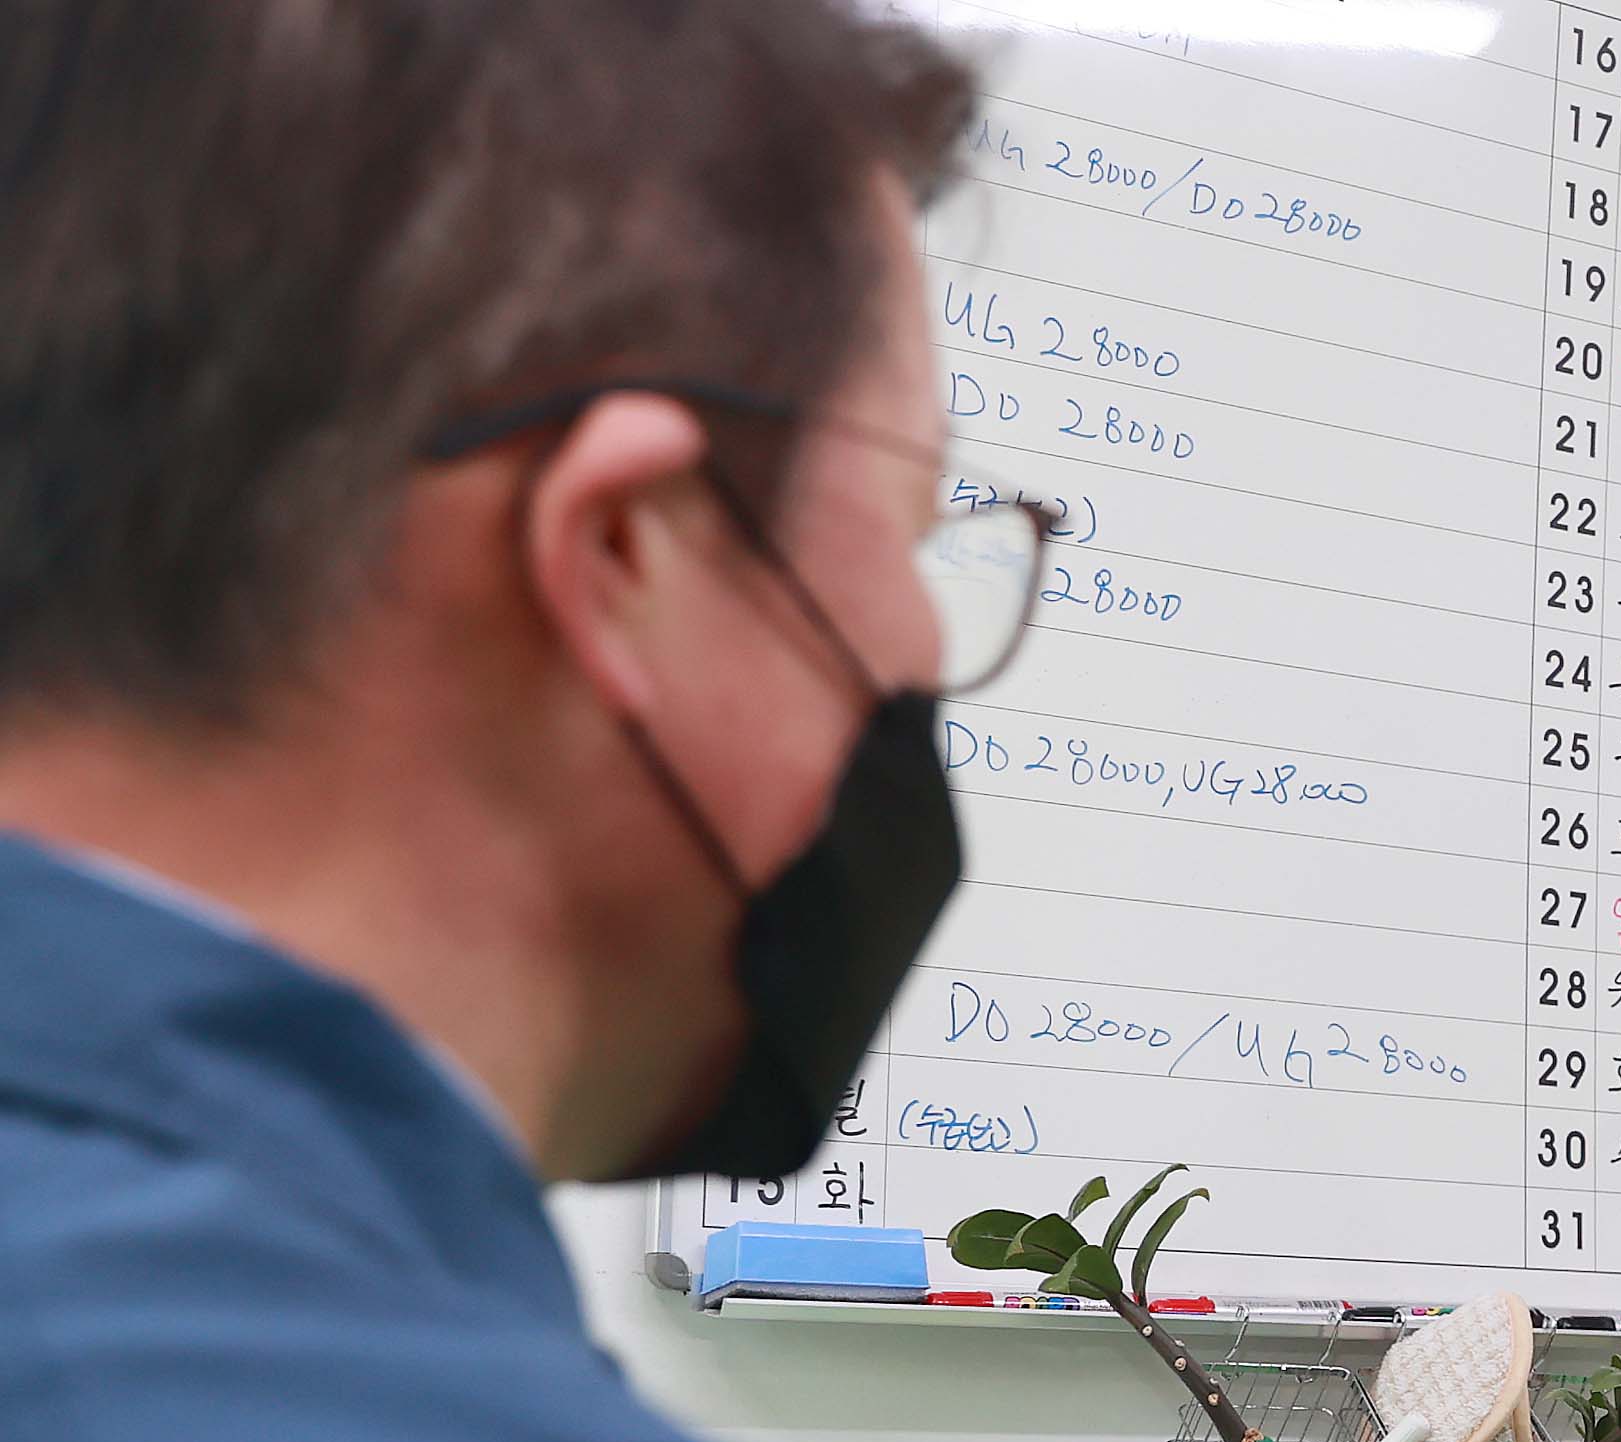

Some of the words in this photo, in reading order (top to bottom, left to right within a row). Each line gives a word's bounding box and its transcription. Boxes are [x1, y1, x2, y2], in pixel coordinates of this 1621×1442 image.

[1571, 27, 1617, 73] 16
[1568, 104, 1614, 149] 17
[1564, 182, 1609, 226] 18
[1560, 259, 1606, 304] 19
[944, 280, 1016, 351] UG
[1041, 317, 1180, 379] 28000
[1554, 336, 1603, 381] 20
[949, 372, 1019, 422] DO
[1059, 398, 1194, 462] 28000
[1556, 414, 1598, 459] 21
[1549, 492, 1598, 537] 22
[1041, 567, 1182, 621] 28000
[1546, 571, 1595, 614] 23
[1544, 649, 1591, 693] 24
[945, 721, 1008, 772] DO
[1543, 729, 1590, 771] 25
[1539, 809, 1589, 851] 26
[1539, 889, 1588, 931] 27
[1539, 967, 1588, 1009] 28
[946, 981, 1010, 1043] DO
[1327, 1023, 1467, 1083] 28000
[1538, 1048, 1588, 1089] 29
[1536, 1129, 1587, 1171] 30
[818, 1162, 874, 1224] 화
[1540, 1210, 1586, 1251] 31
